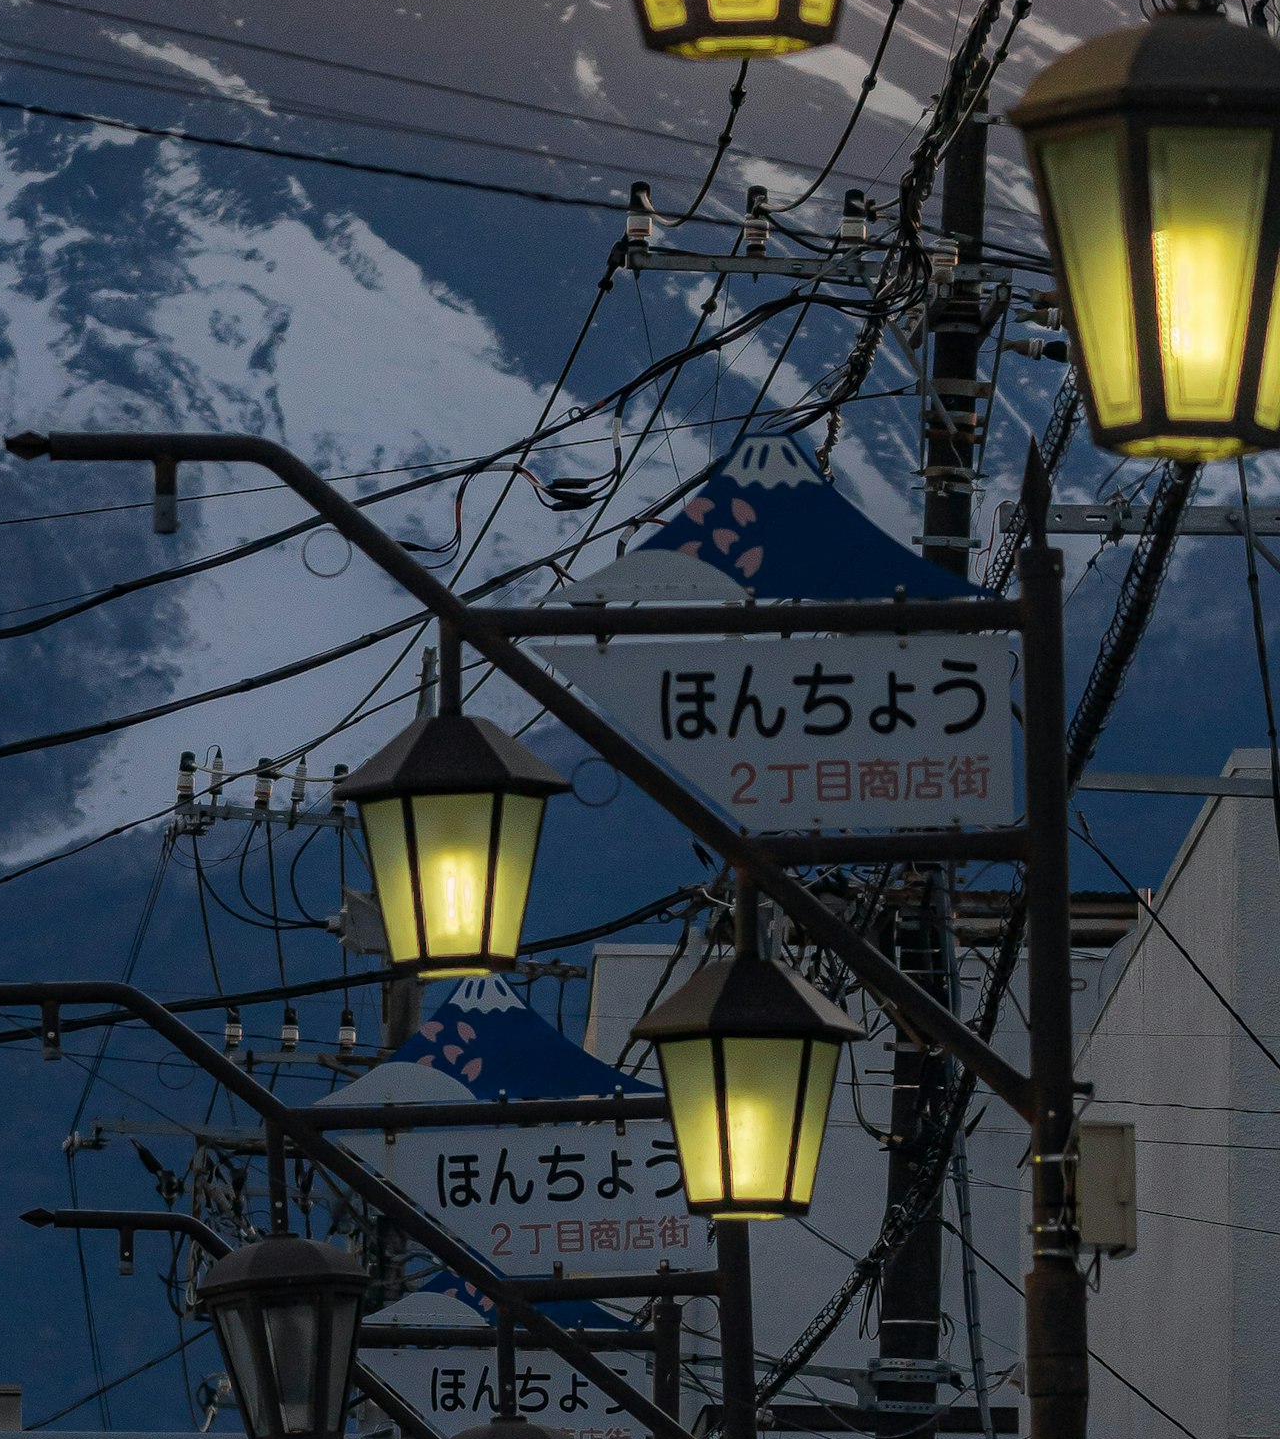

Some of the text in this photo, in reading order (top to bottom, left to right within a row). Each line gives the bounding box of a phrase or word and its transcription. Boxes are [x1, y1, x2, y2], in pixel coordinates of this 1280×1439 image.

[659, 658, 988, 743] ほんちょう
[728, 753, 992, 805] 2丁目商店街
[436, 1138, 688, 1209] ほんちょう
[489, 1213, 694, 1258] 2丁目商店街
